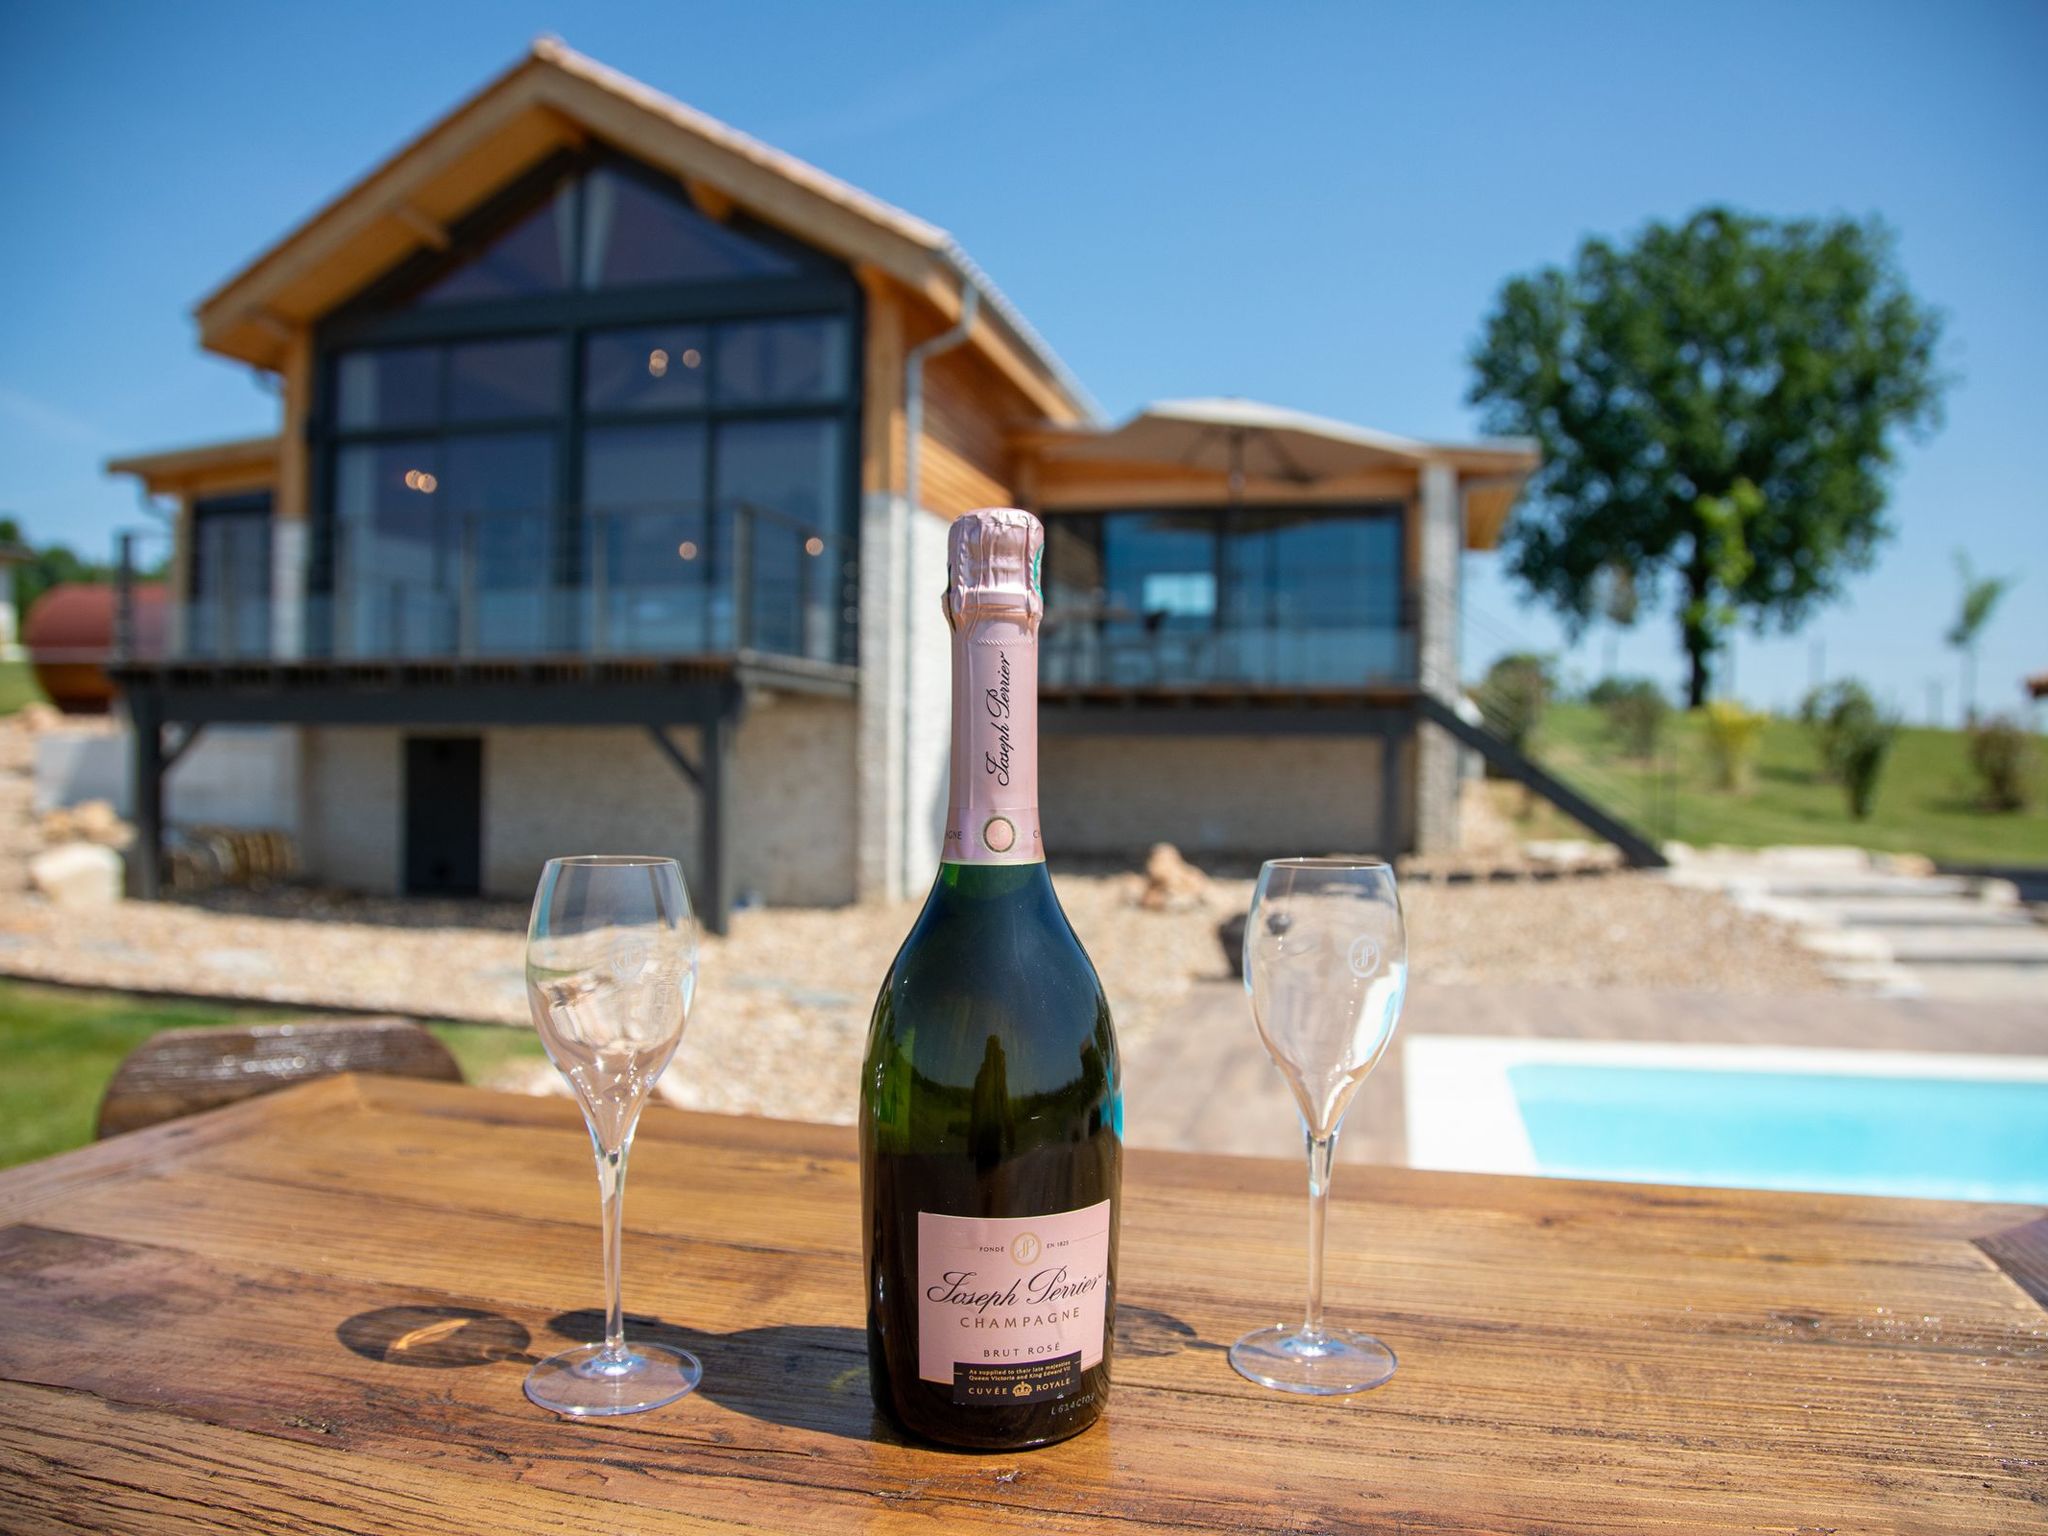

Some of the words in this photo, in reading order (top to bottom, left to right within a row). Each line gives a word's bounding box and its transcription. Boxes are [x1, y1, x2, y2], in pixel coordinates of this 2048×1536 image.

[985, 651, 1011, 719] Perrier
[985, 722, 1014, 787] Joseph
[926, 1271, 1021, 1314] Joseph
[1026, 1265, 1105, 1305] Perrier
[960, 1306, 1080, 1329] CHAMPAGNE
[983, 1349, 1020, 1358] BRUT
[1028, 1342, 1061, 1354] ROSÉ
[968, 1386, 1008, 1395] CUVÉE
[1036, 1377, 1071, 1392] ROYALE
